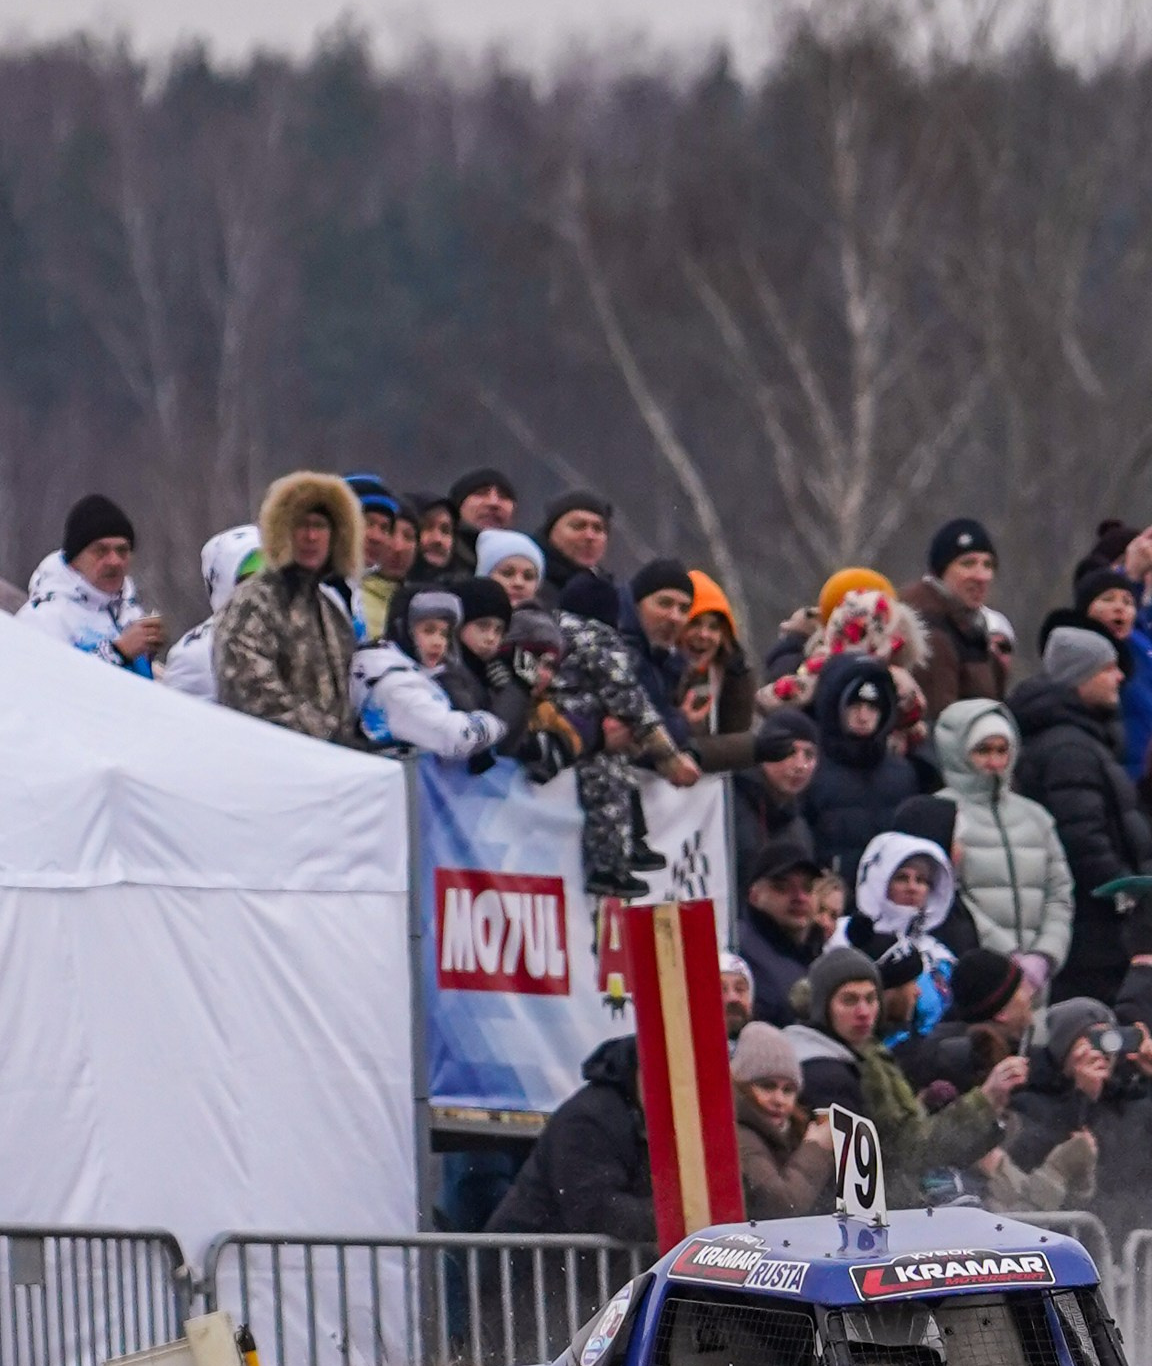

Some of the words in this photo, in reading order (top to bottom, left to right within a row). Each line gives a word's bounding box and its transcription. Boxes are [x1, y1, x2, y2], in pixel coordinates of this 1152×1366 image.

[441, 888, 566, 978] MOTUL
[833, 1108, 877, 1209] 79
[693, 1245, 761, 1270] KRAMAR
[894, 1256, 1046, 1282] KRAMAR
[749, 1262, 805, 1290] RUSTA
[945, 1272, 1046, 1285] MOTORSPORT
